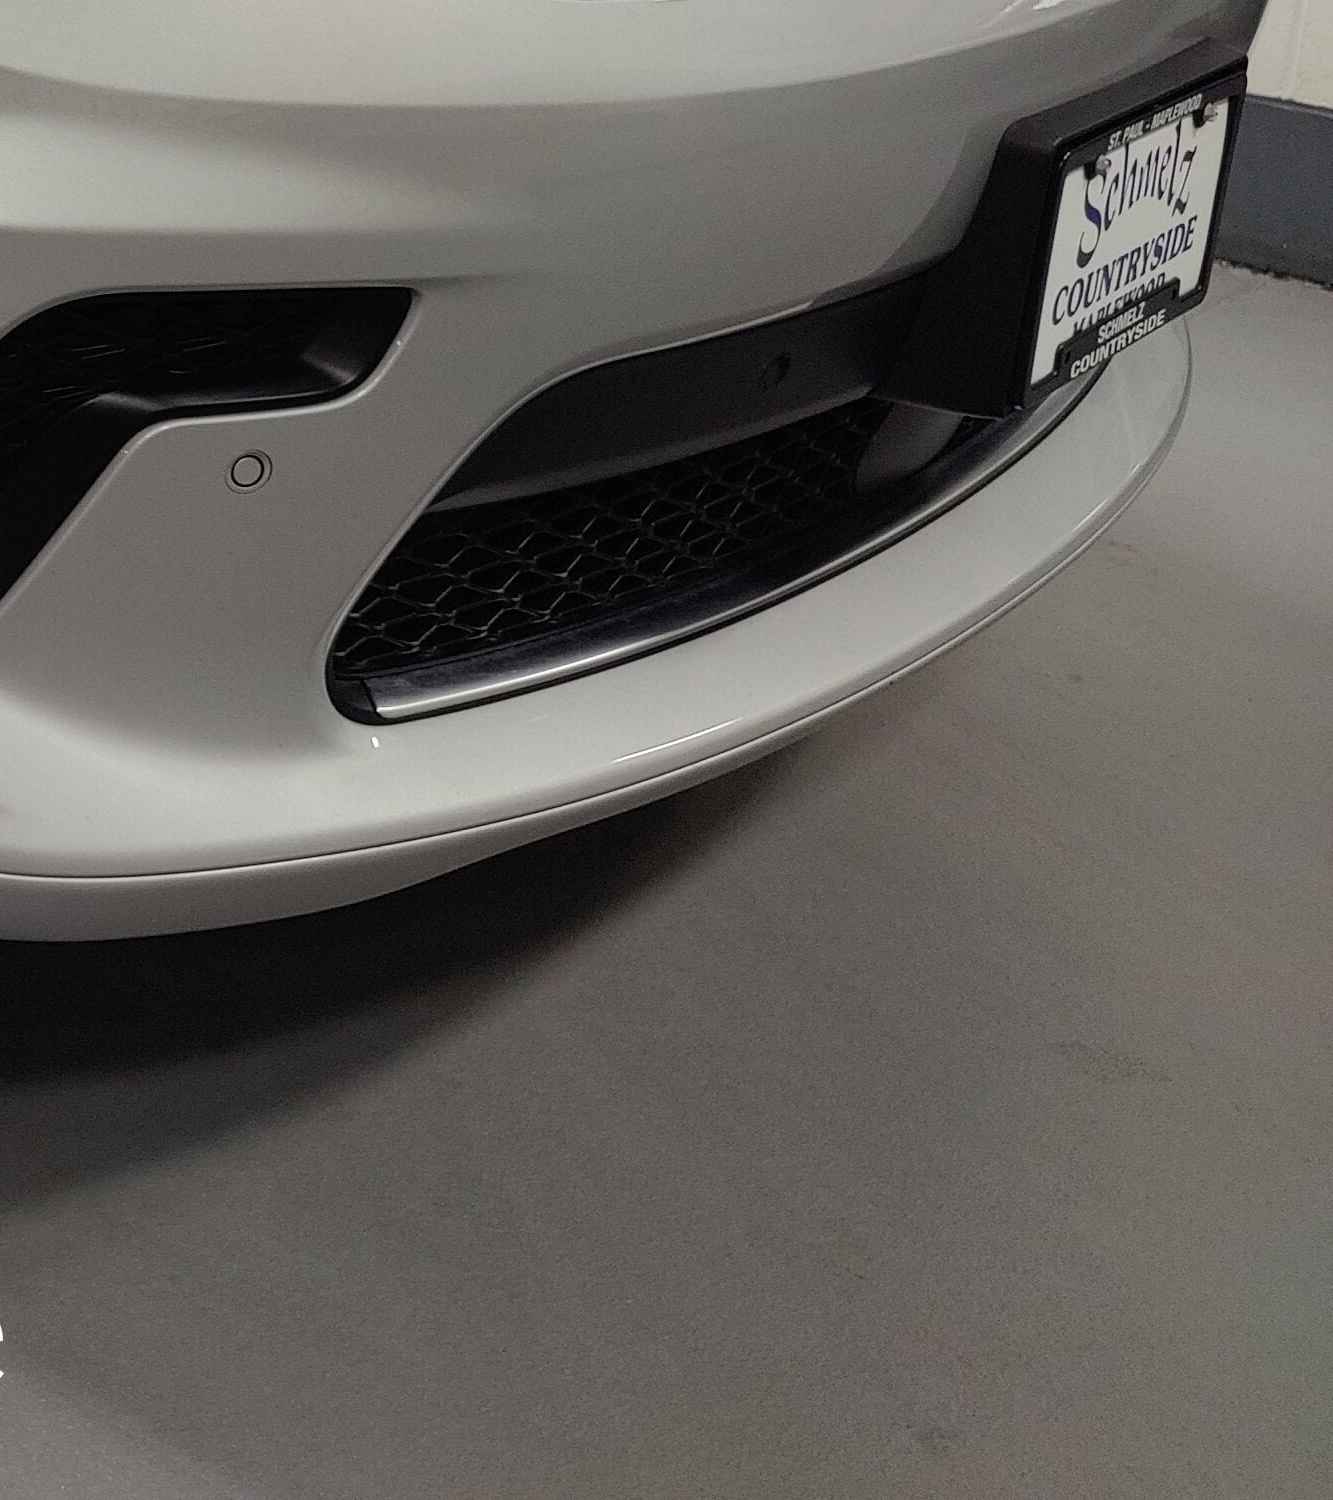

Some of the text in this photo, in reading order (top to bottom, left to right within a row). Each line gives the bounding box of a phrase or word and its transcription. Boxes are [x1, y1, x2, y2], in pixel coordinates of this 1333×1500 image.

[1076, 118, 1198, 268] Schmelz
[1052, 215, 1198, 326] COUNTRYSIDE
[1070, 308, 1167, 379] COUNTRYSIDE
[1097, 301, 1146, 344] SCHMELZ
